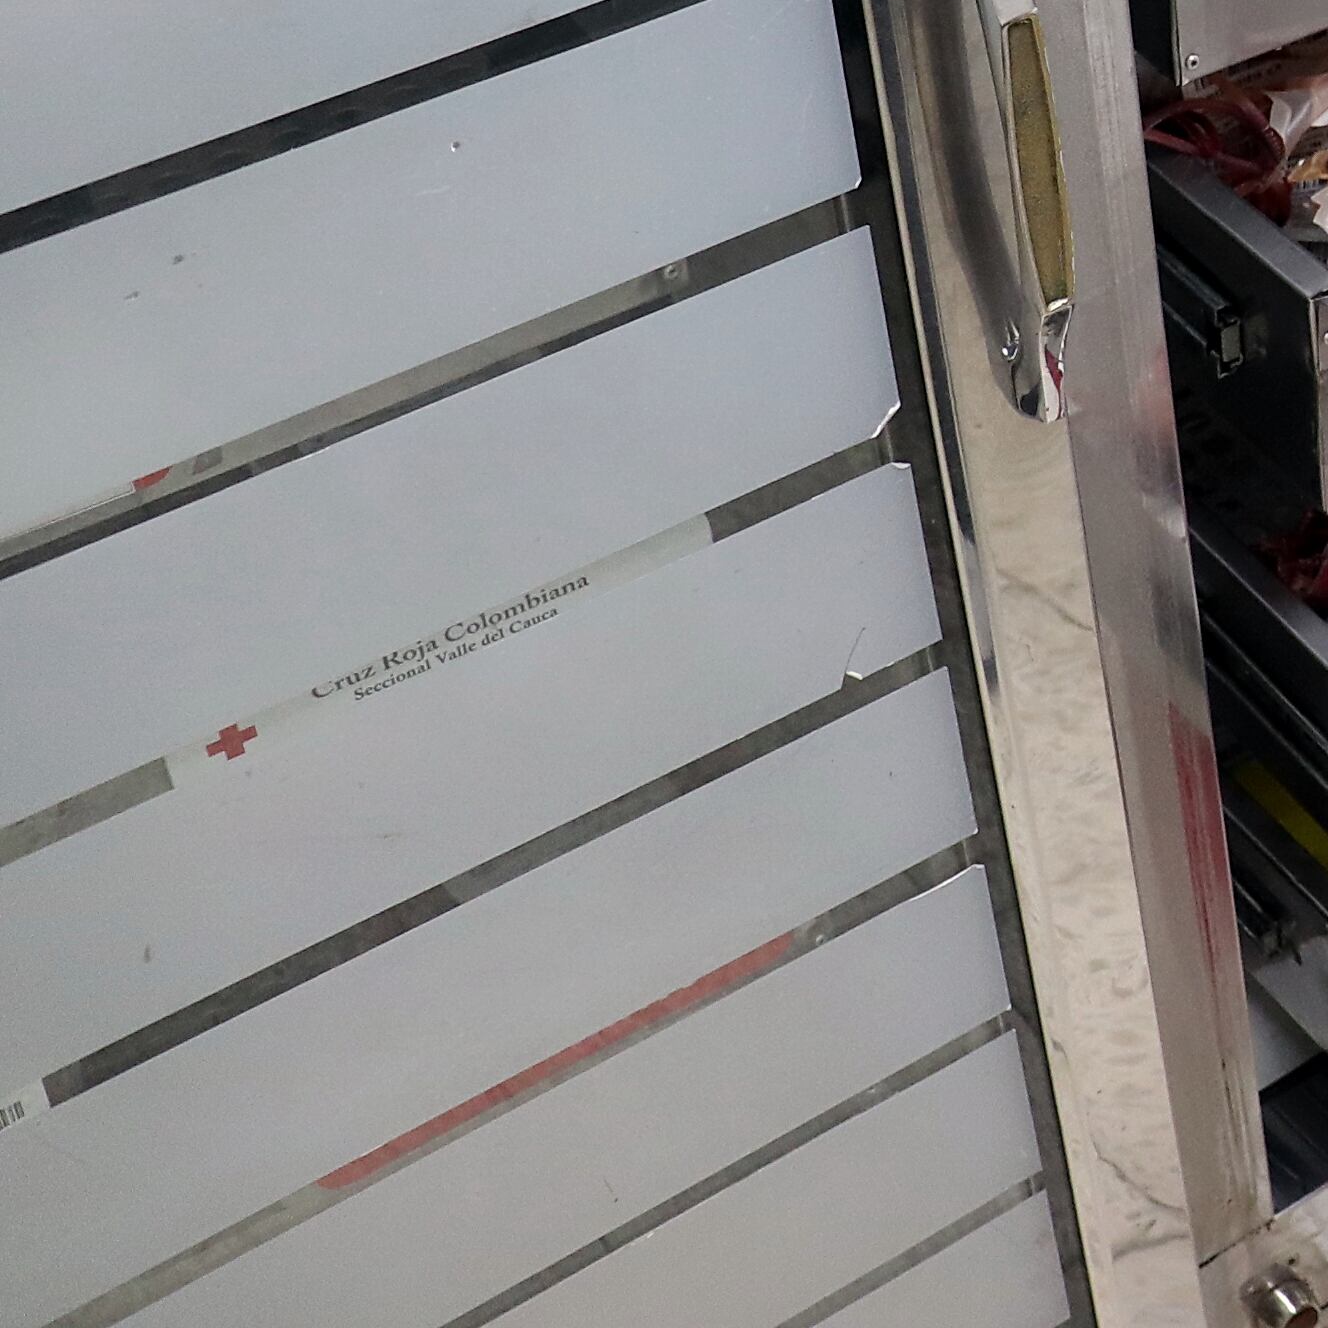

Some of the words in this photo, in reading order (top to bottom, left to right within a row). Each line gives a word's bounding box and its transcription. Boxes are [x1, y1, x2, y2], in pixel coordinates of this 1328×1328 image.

[311, 665, 377, 699] Cruz
[382, 638, 440, 671] Roja
[444, 574, 590, 643] Colombiana
[353, 660, 432, 702] Seccional
[436, 642, 477, 665] Valle
[481, 627, 505, 647] del
[508, 606, 560, 635] Cauca
